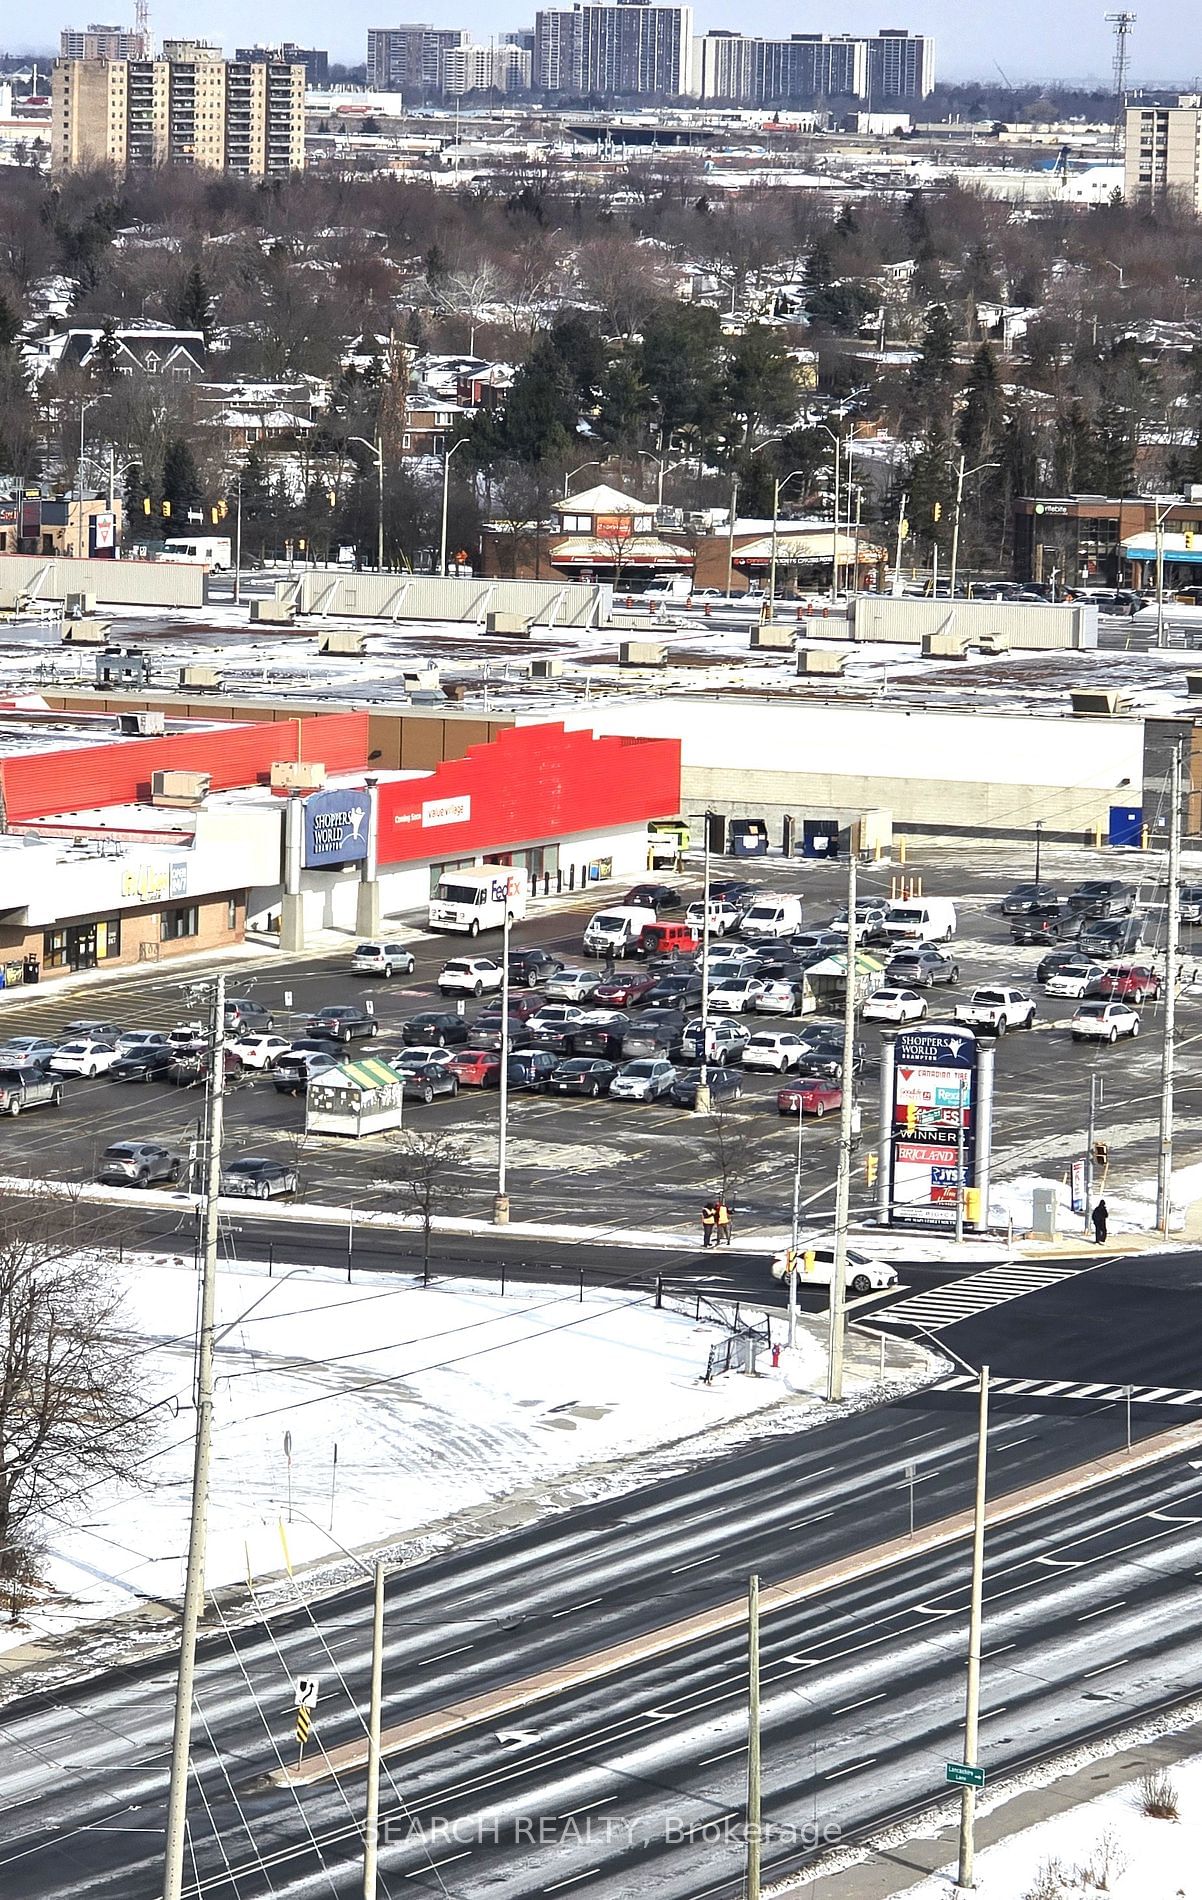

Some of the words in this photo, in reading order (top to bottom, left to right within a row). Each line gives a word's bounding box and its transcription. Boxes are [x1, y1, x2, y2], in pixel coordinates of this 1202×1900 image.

[315, 811, 352, 829] SHOPPERS
[315, 828, 342, 844] WORLD
[492, 876, 520, 900] FedEx
[902, 1036, 949, 1047] SHOPPERS
[902, 1045, 938, 1055] WORLD
